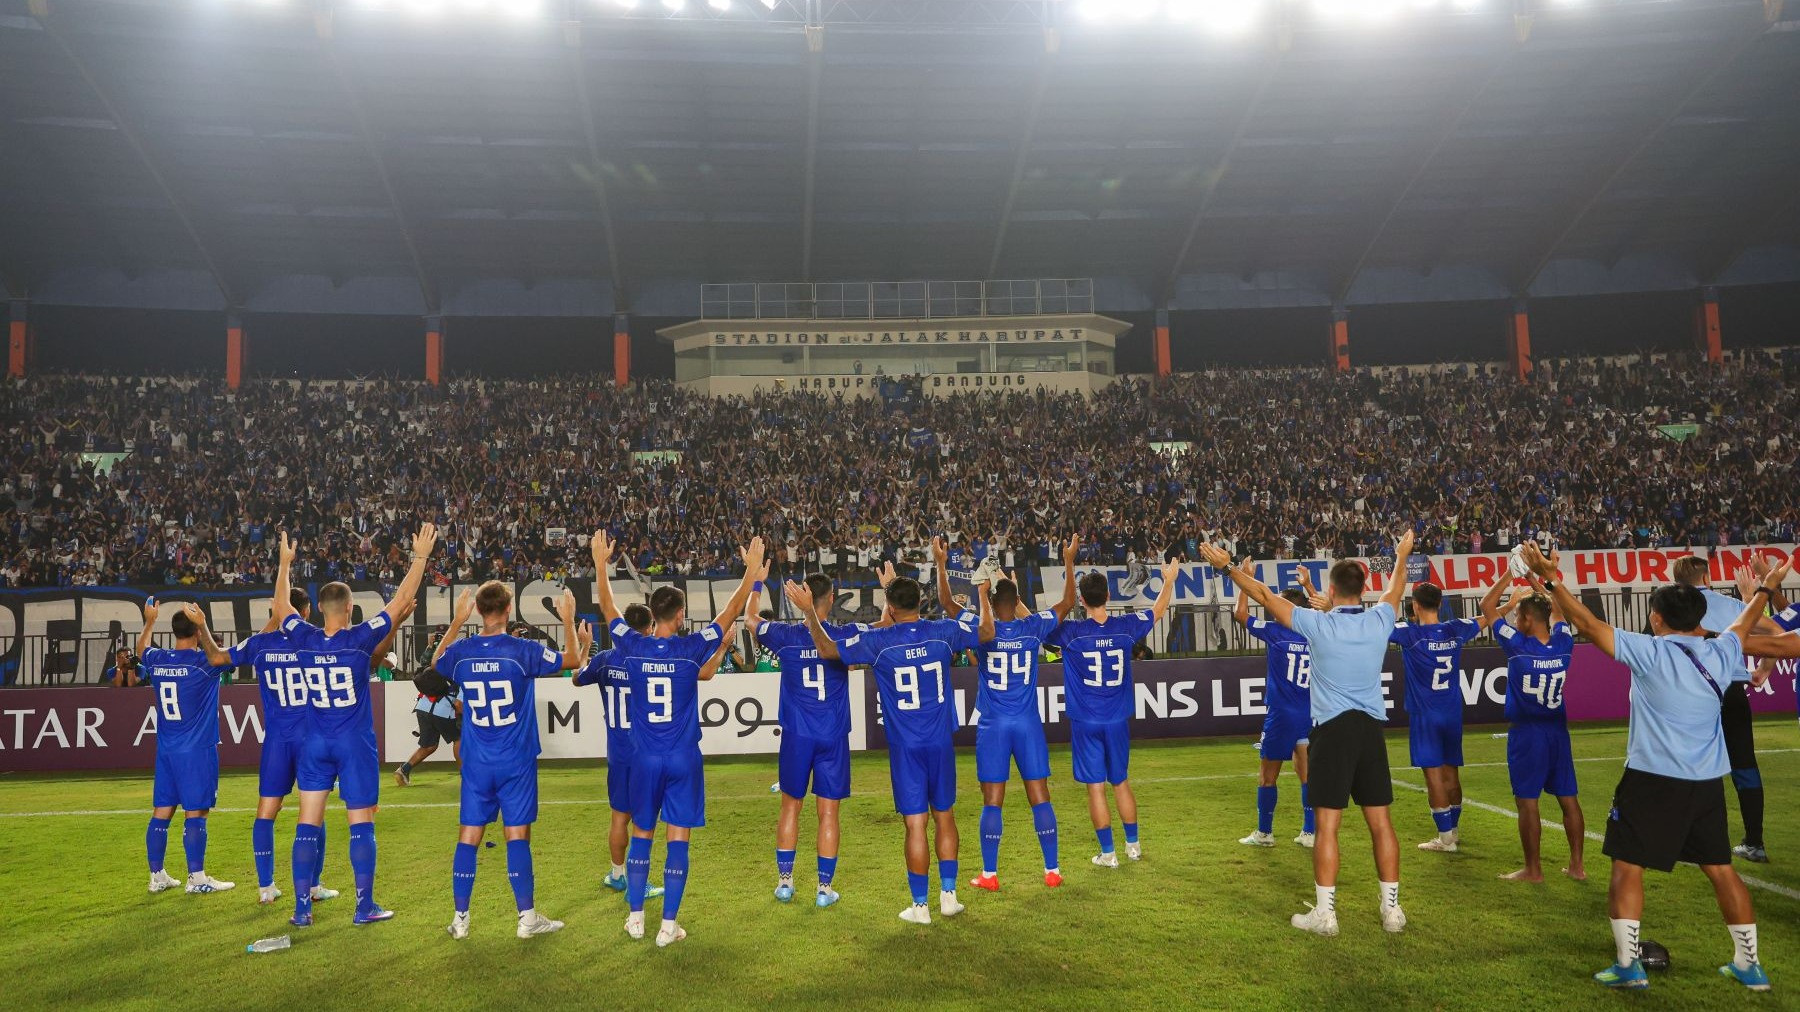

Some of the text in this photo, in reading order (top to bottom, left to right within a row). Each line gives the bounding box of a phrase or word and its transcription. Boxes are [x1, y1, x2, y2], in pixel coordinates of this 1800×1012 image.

[715, 333, 829, 344] STADION
[862, 332, 949, 343] JALAK
[933, 375, 1026, 388] BANDUNG
[1706, 546, 1800, 582] IND
[799, 649, 818, 659] JULIO
[905, 647, 928, 660] BERG
[1095, 638, 1114, 648] HAYE
[471, 660, 500, 673] LONČAR
[642, 662, 675, 673] MENALO
[802, 663, 826, 702] 4
[894, 661, 945, 711] 97
[987, 650, 1032, 691] 94
[1081, 648, 1125, 687] 33
[1286, 652, 1311, 689] 18
[1431, 655, 1453, 691] 2
[160, 681, 182, 721] 8
[263, 666, 309, 707] 48
[304, 666, 357, 708] 99
[463, 680, 517, 727] 22
[646, 676, 672, 723] 9
[1522, 669, 1567, 709] 40
[0, 706, 109, 750] TAR
